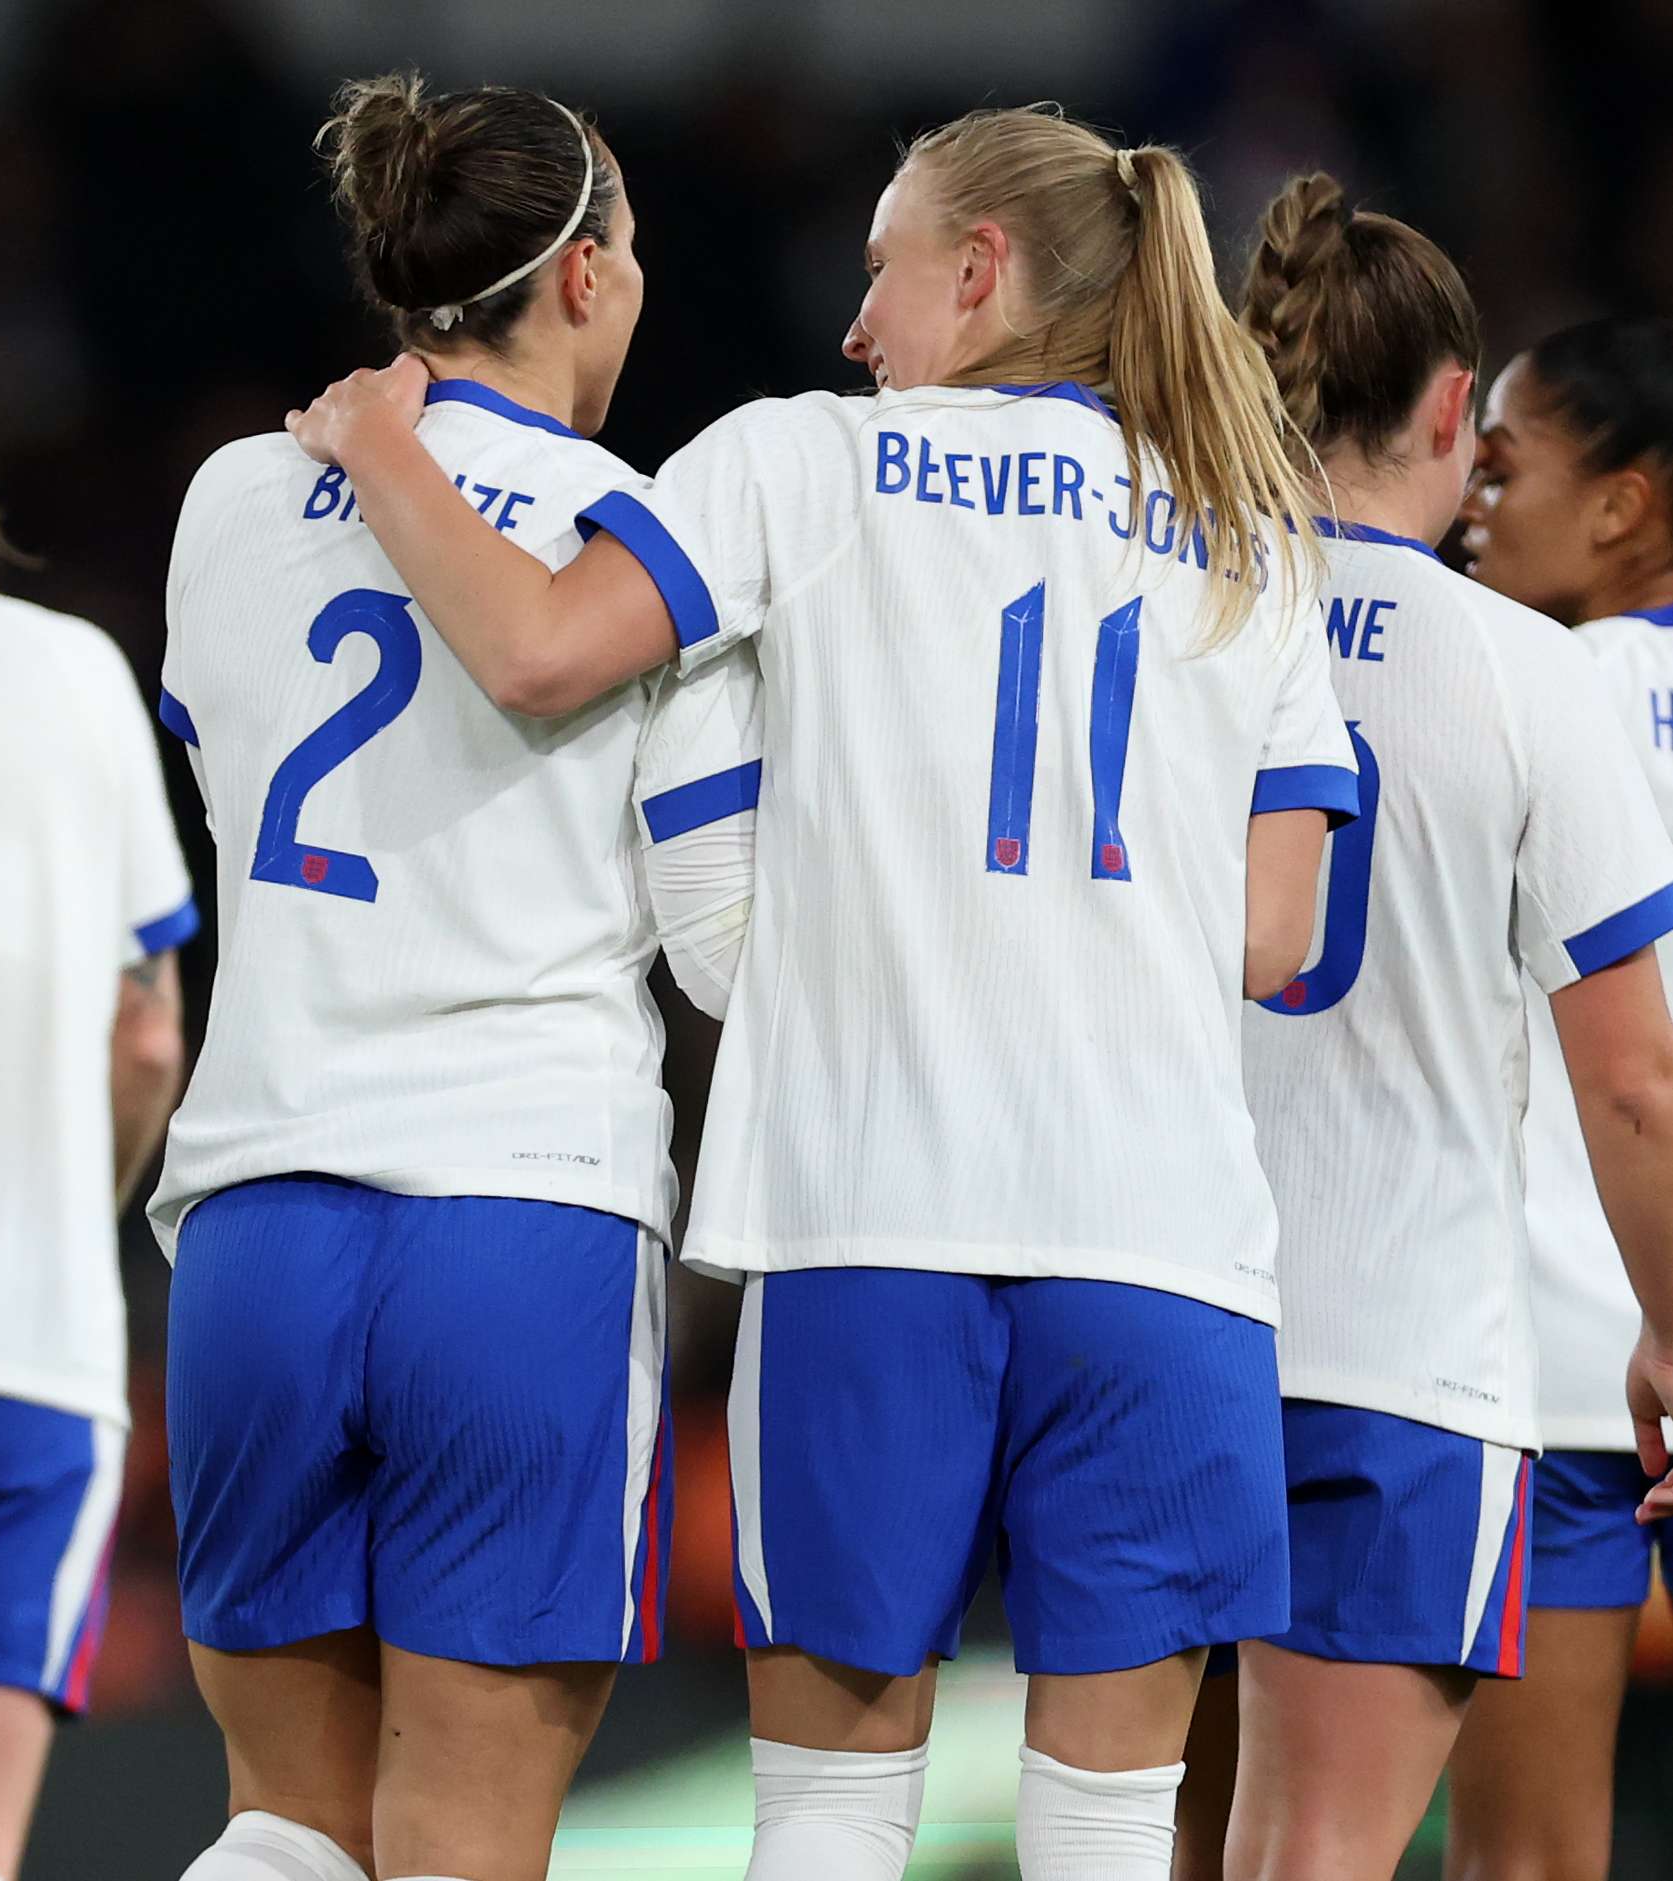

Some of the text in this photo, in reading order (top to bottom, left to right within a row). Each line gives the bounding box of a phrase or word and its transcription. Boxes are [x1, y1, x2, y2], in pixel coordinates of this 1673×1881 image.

[302, 464, 536, 533] BZE
[249, 588, 422, 903] 2
[985, 577, 1143, 882] 11
